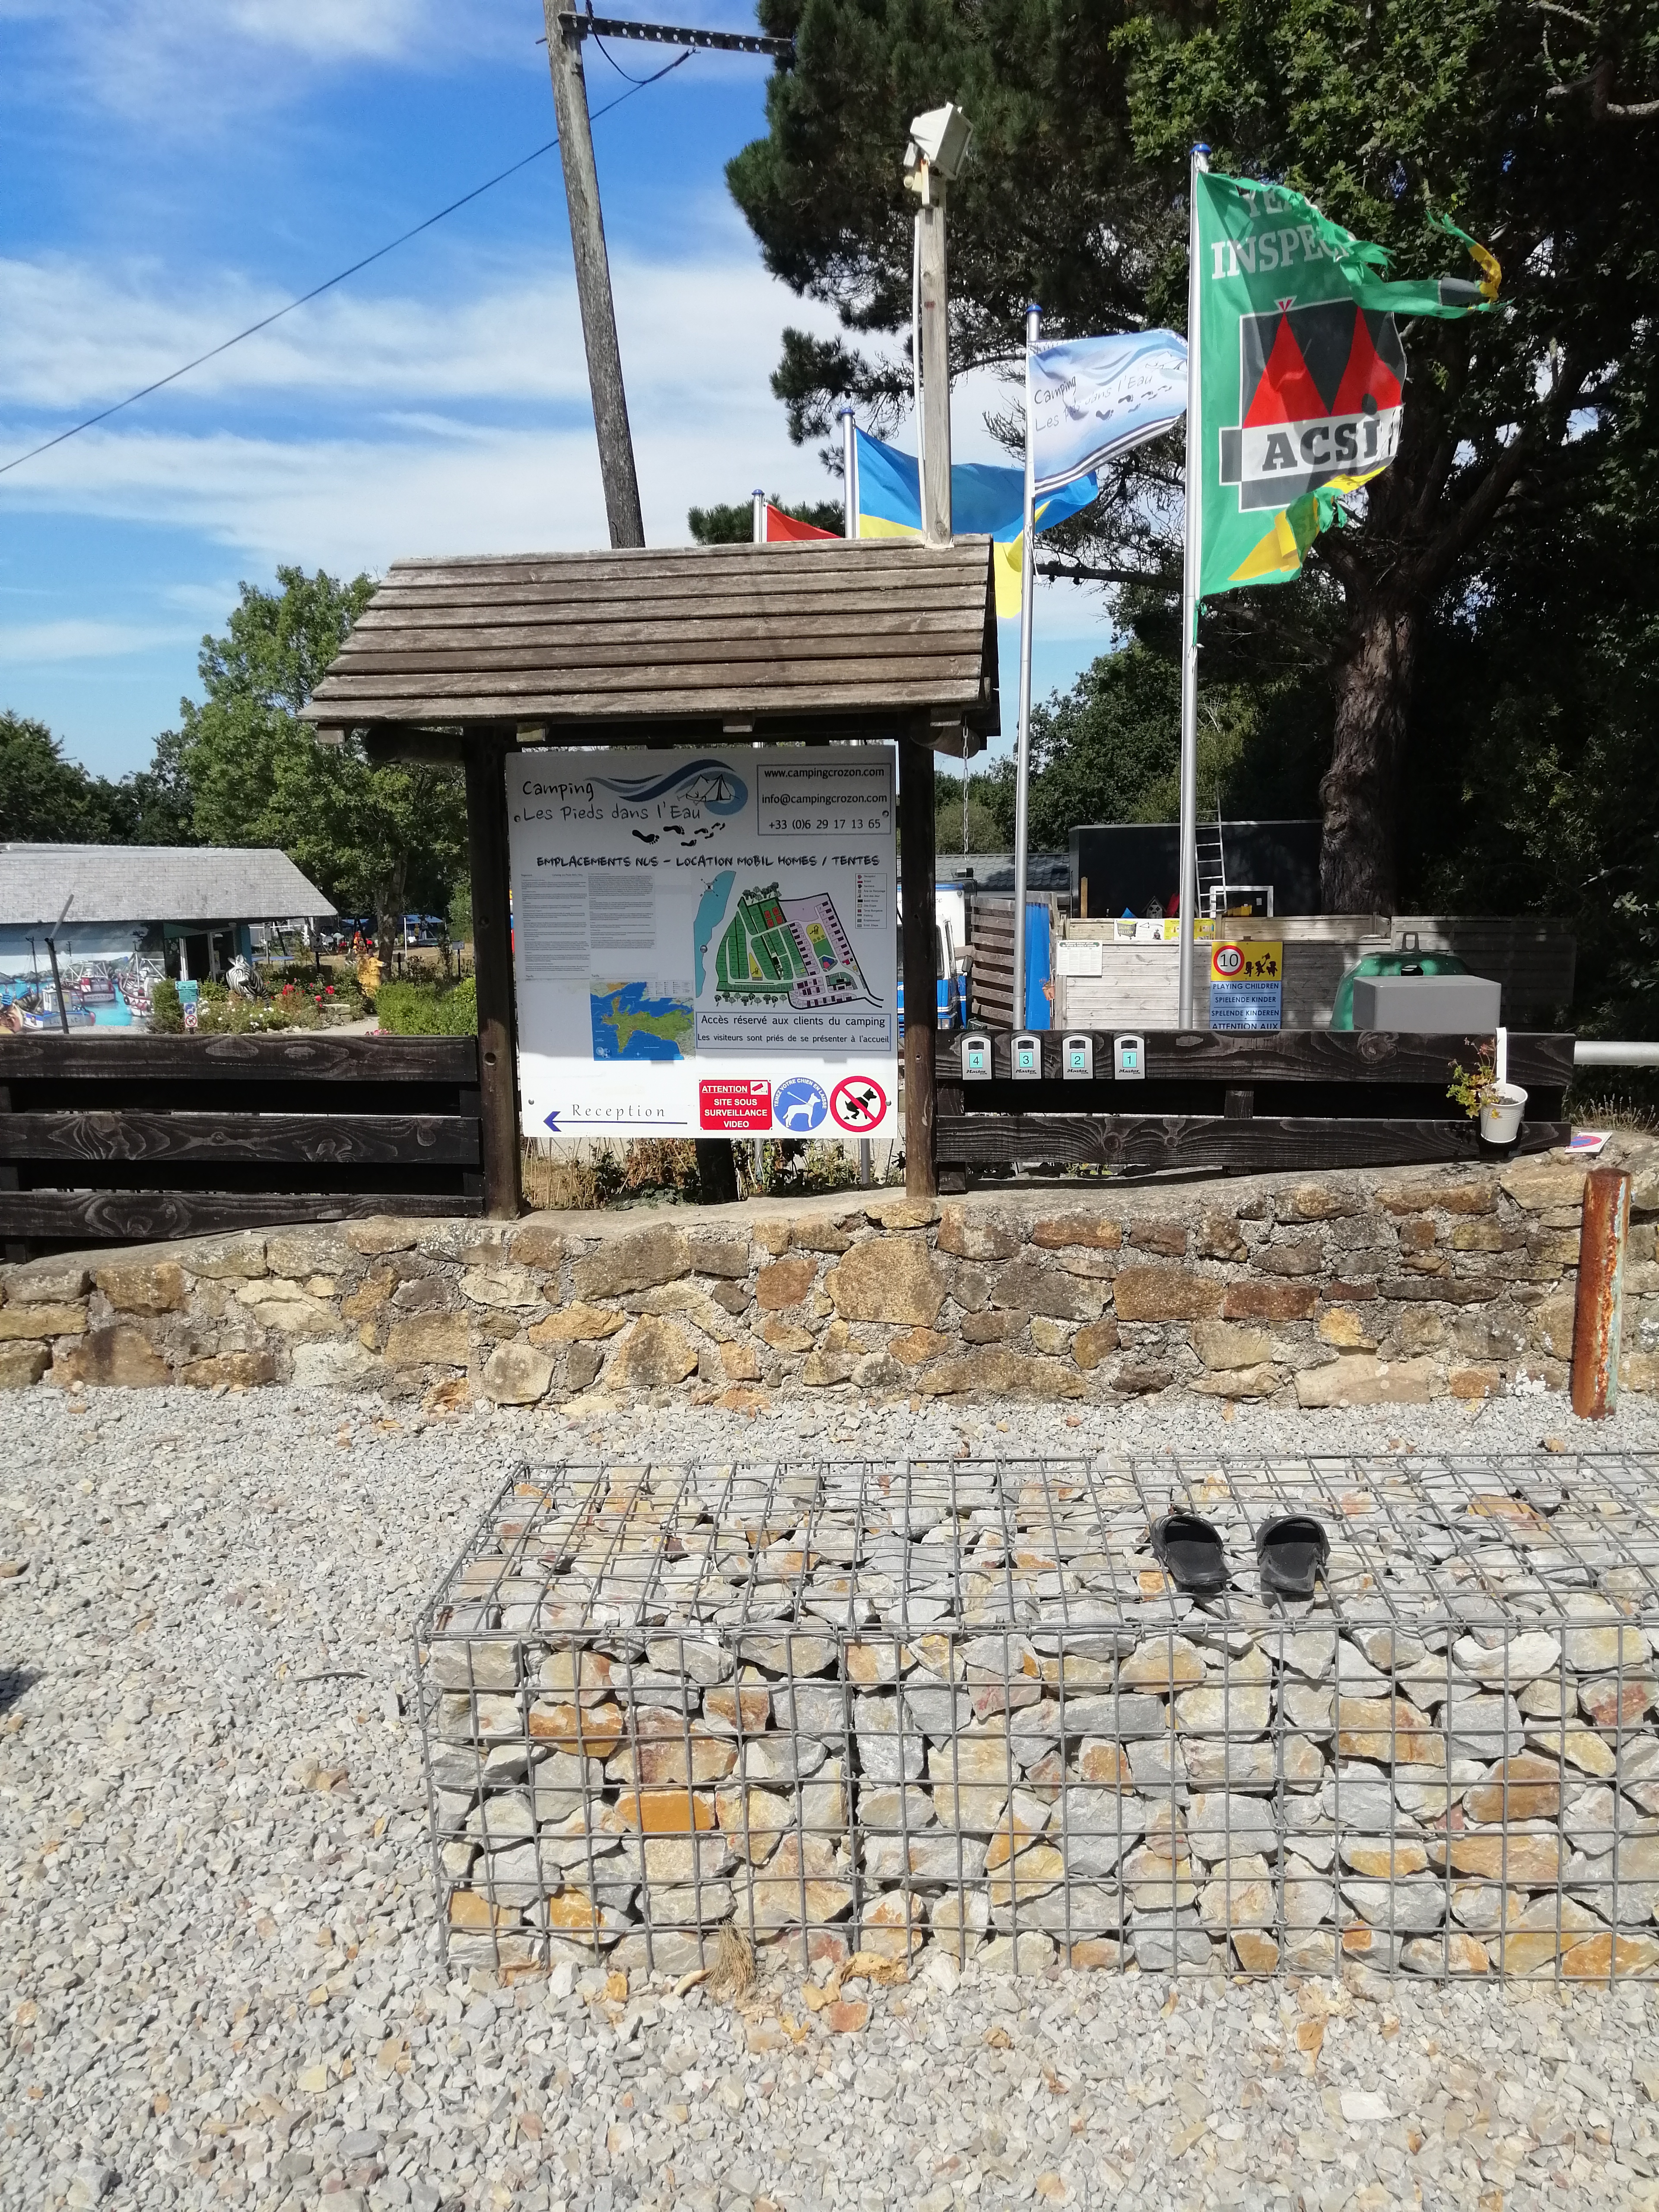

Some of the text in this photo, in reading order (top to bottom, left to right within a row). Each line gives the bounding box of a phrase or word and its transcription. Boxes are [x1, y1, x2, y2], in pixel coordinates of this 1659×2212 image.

[1034, 376, 1076, 406] Camping
[1035, 415, 1059, 431] Les
[764, 767, 884, 779] www.campingcrozon.com
[522, 781, 594, 802] Camping
[762, 793, 887, 806] info@campingcrozon.com
[523, 801, 700, 821] Les Pieds dans l'Eau
[769, 819, 880, 830] +33 (0)6 29 17 13 65
[536, 855, 631, 867] EMPLACEMENTS
[635, 856, 659, 867] NUS
[676, 855, 734, 867] LOCATION
[737, 855, 774, 867] MOBIL
[778, 855, 817, 866] HOMES
[832, 855, 880, 866] TENTES
[1220, 953, 1239, 967] 10
[701, 1015, 729, 1024] Accès
[734, 1015, 767, 1025] réservé
[793, 1016, 823, 1025] clients
[828, 1017, 840, 1025] du
[845, 1018, 885, 1028] camping
[766, 1034, 784, 1043] priés
[812, 1035, 847, 1043] présenter
[859, 1035, 890, 1043] l'accueil
[973, 1056, 979, 1065] 4
[1023, 1055, 1030, 1065] 3
[1074, 1055, 1081, 1065] 2
[1127, 1055, 1132, 1065] 1
[779, 1079, 796, 1091] VOTRE
[818, 1090, 827, 1109] LAISSE
[571, 1104, 666, 1121] Reception
